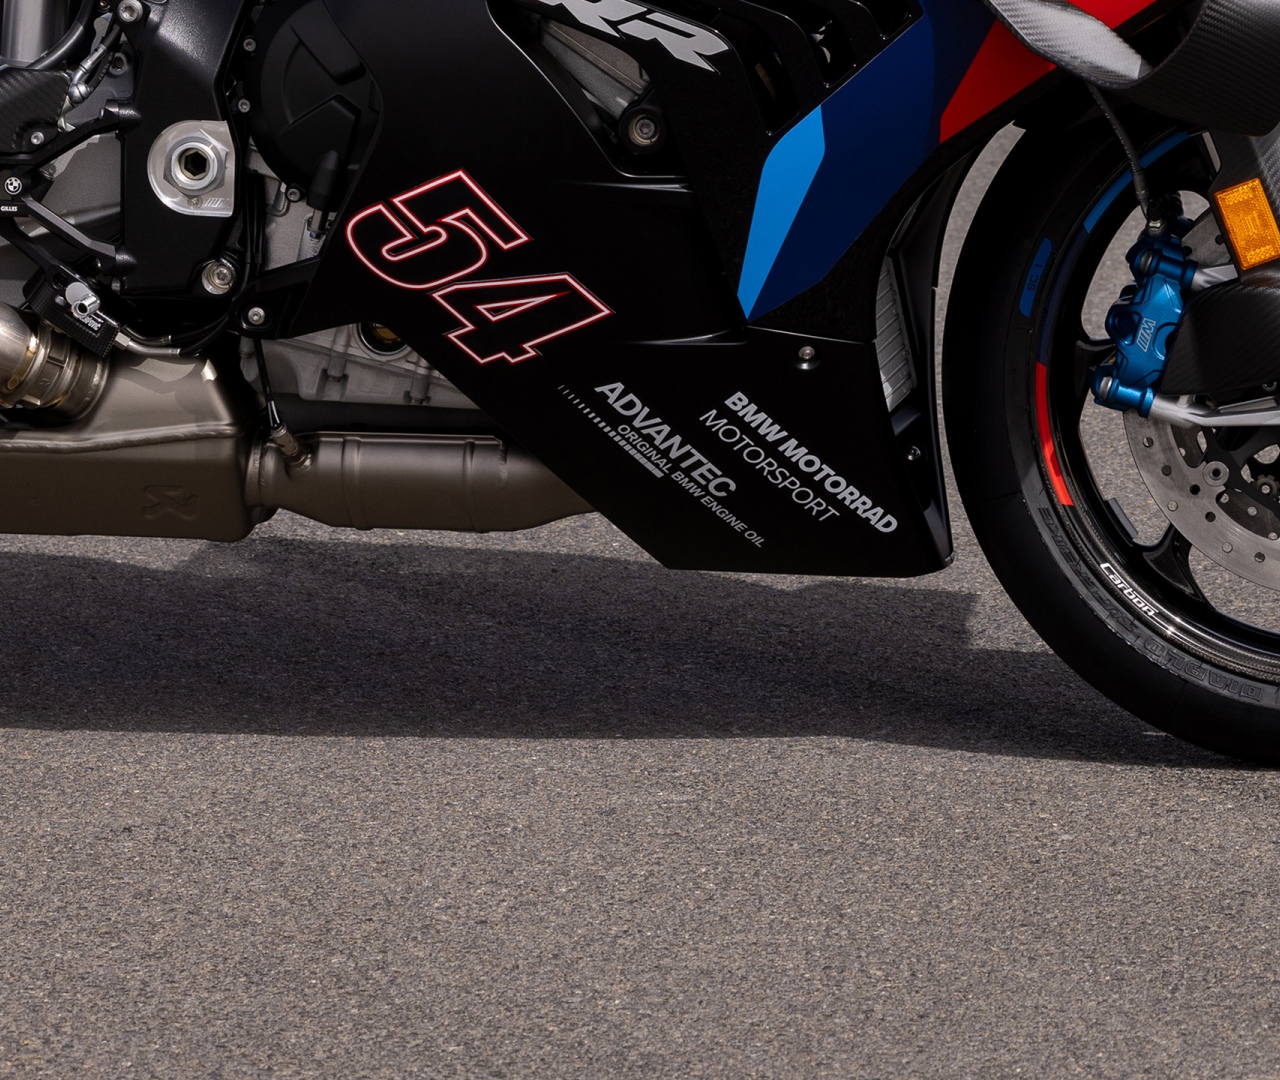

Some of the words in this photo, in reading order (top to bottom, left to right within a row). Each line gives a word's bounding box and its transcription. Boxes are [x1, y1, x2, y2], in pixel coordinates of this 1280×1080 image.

[346, 169, 614, 366] 54
[1027, 273, 1039, 291] SC
[594, 382, 736, 497] ADVANTEC
[617, 424, 672, 473] ORIGINAL
[671, 471, 705, 497] BMW
[700, 495, 748, 532] ENGINE
[744, 530, 765, 547] OIL
[699, 409, 840, 521] MOTORSPORT
[724, 391, 788, 442] BMW
[778, 438, 898, 533] MOTORRAD
[1143, 636, 1266, 702] DIABLO
